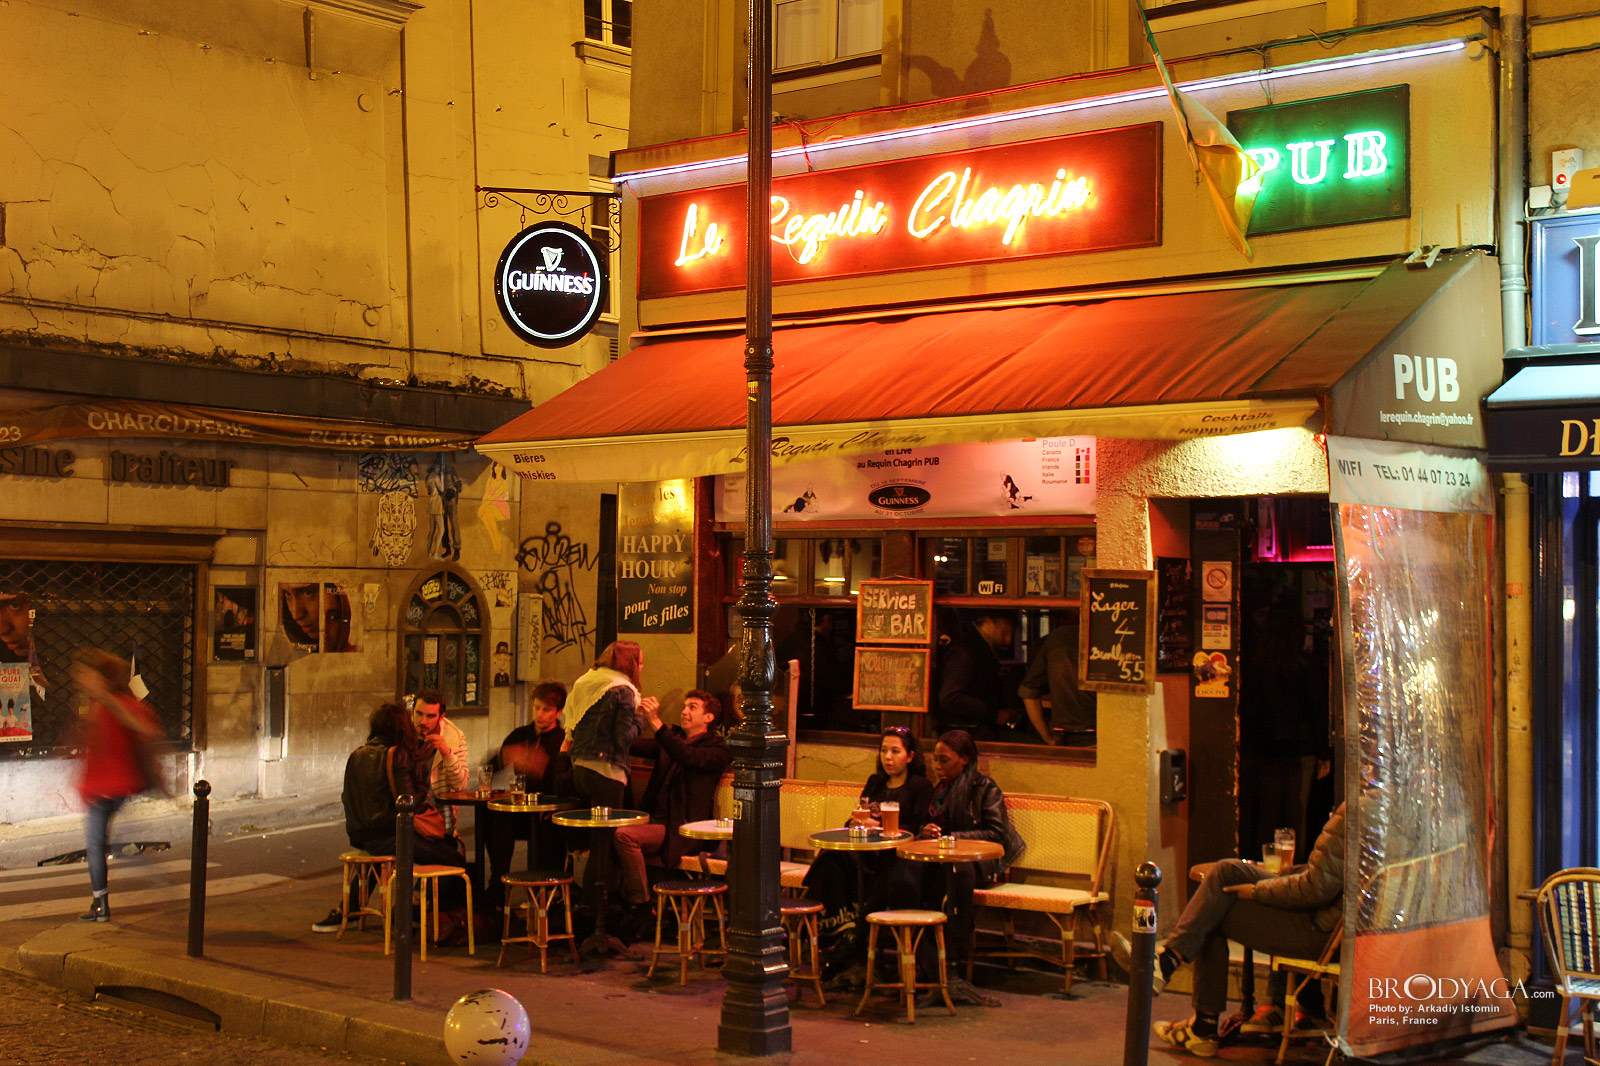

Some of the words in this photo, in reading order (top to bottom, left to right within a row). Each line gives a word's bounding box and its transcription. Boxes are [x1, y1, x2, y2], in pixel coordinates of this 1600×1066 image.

[675, 204, 722, 266] Le
[908, 167, 1090, 244] Chagrin
[508, 271, 594, 295] GUINNESS
[1393, 354, 1460, 402] PUB
[87, 411, 254, 438] CHARCUTERIE
[1201, 412, 1274, 423] Cocktails
[1379, 410, 1474, 426] lerequin.chagrin@yahoo.fr
[1042, 440, 1067, 448] Poule
[1069, 438, 1076, 447] D
[110, 450, 237, 486] traiteur
[513, 454, 546, 464] Bières
[857, 461, 866, 469] au
[867, 459, 892, 470] Requin
[893, 458, 923, 469] Chagrin
[924, 457, 940, 466] PUB
[1373, 464, 1401, 480] TEL:
[1401, 466, 1415, 482] 01
[1417, 468, 1428, 483] 44
[1430, 469, 1442, 485] 07
[1445, 471, 1456, 486] 23
[1459, 472, 1471, 487] 24
[658, 487, 676, 502] les
[878, 496, 919, 505] GUINNESS
[622, 534, 686, 554] HAPPY
[621, 559, 677, 579] HOUR
[648, 583, 666, 595] Non
[668, 583, 687, 596] stop
[624, 599, 651, 620] pour
[643, 612, 658, 628] les
[659, 604, 689, 627] filles
[1091, 591, 1140, 622] Lager
[890, 613, 926, 636] BAR
[1115, 618, 1136, 643] 4
